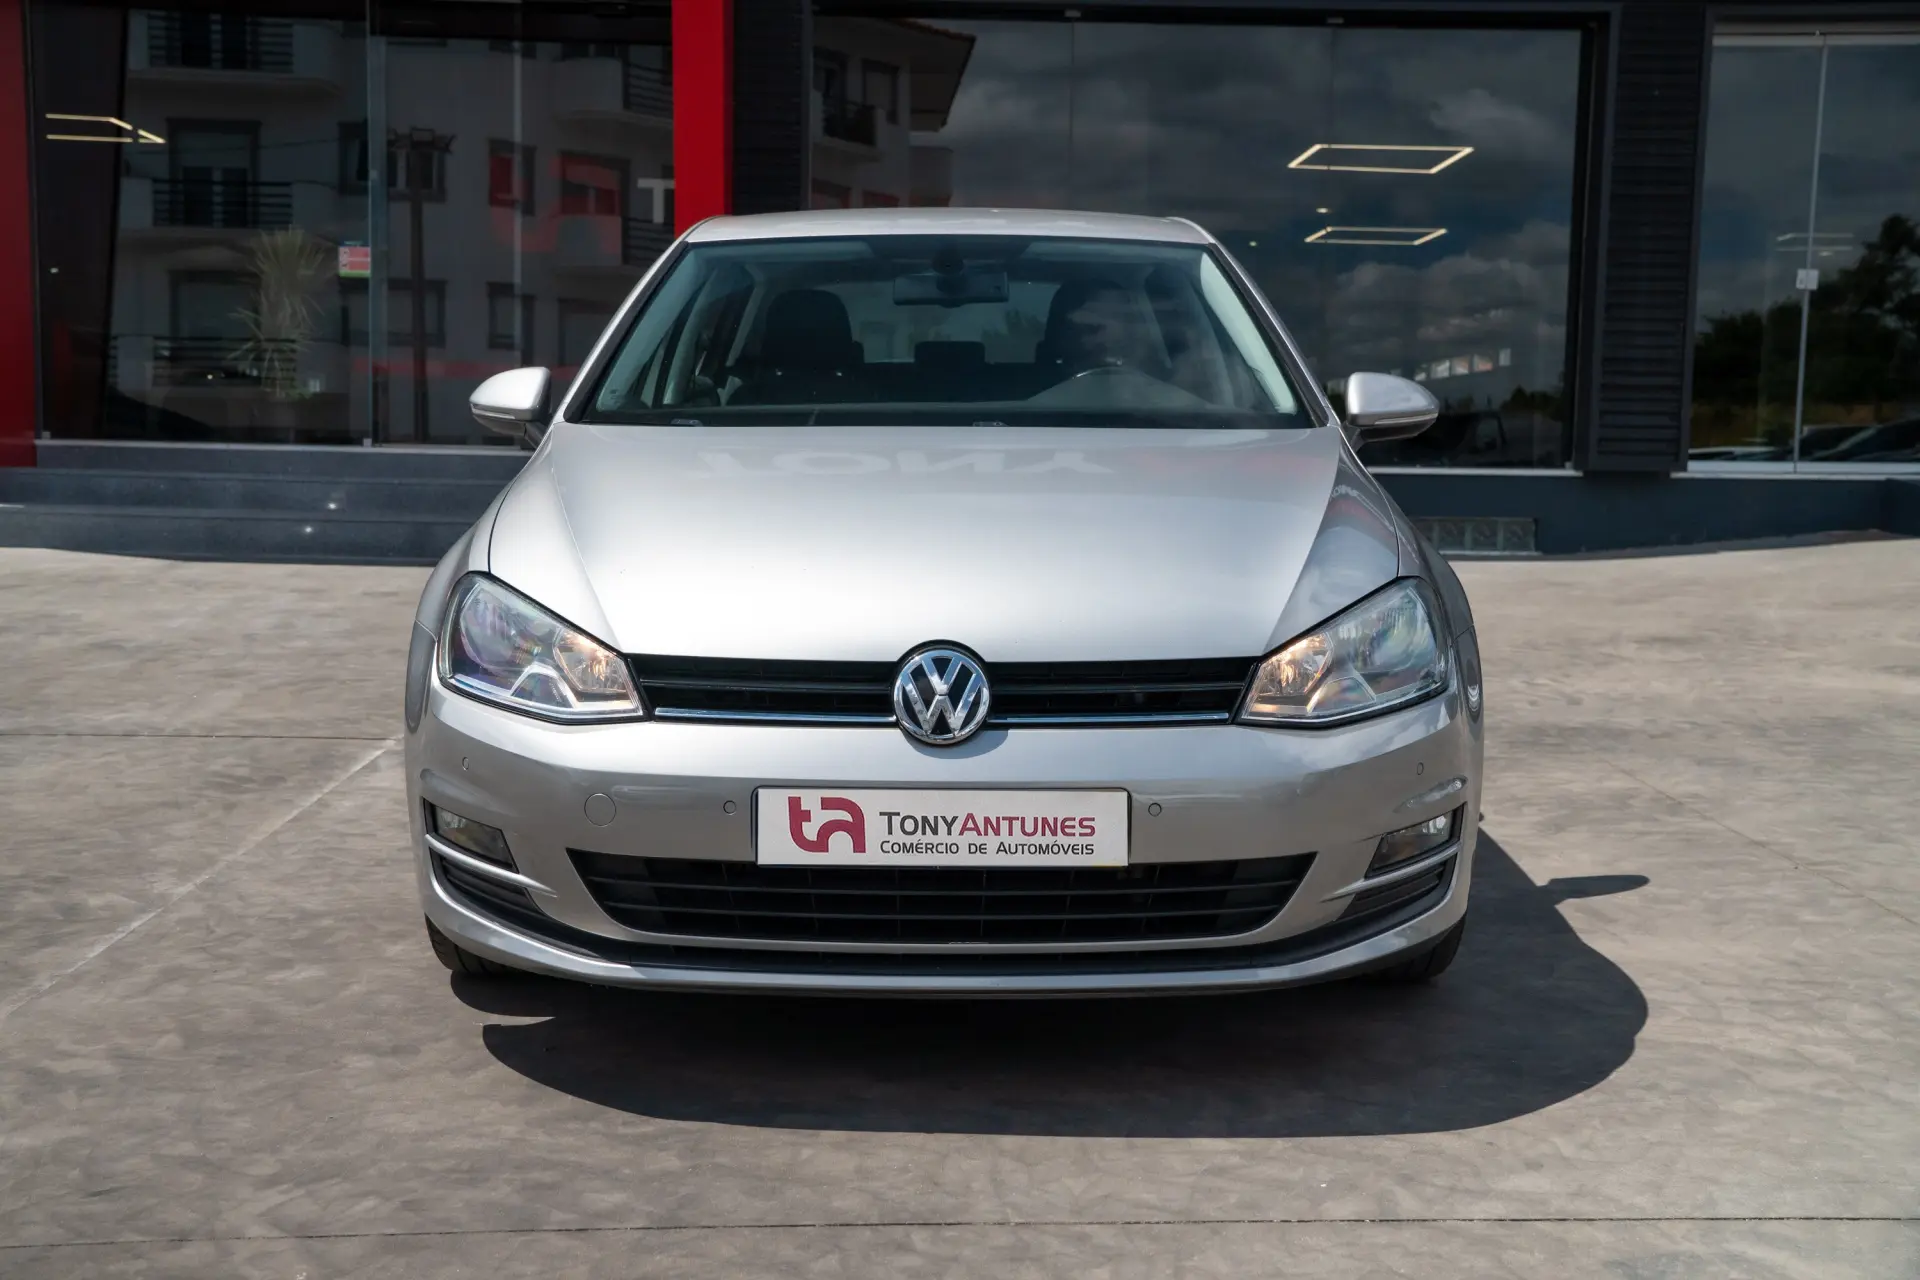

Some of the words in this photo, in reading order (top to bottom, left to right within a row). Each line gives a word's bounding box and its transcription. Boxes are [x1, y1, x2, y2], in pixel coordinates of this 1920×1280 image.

[896, 651, 987, 741] VW
[879, 838, 960, 855] COMÉRCIO
[967, 842, 989, 855] DE
[995, 839, 1095, 856] AUTOMÓVEIS
